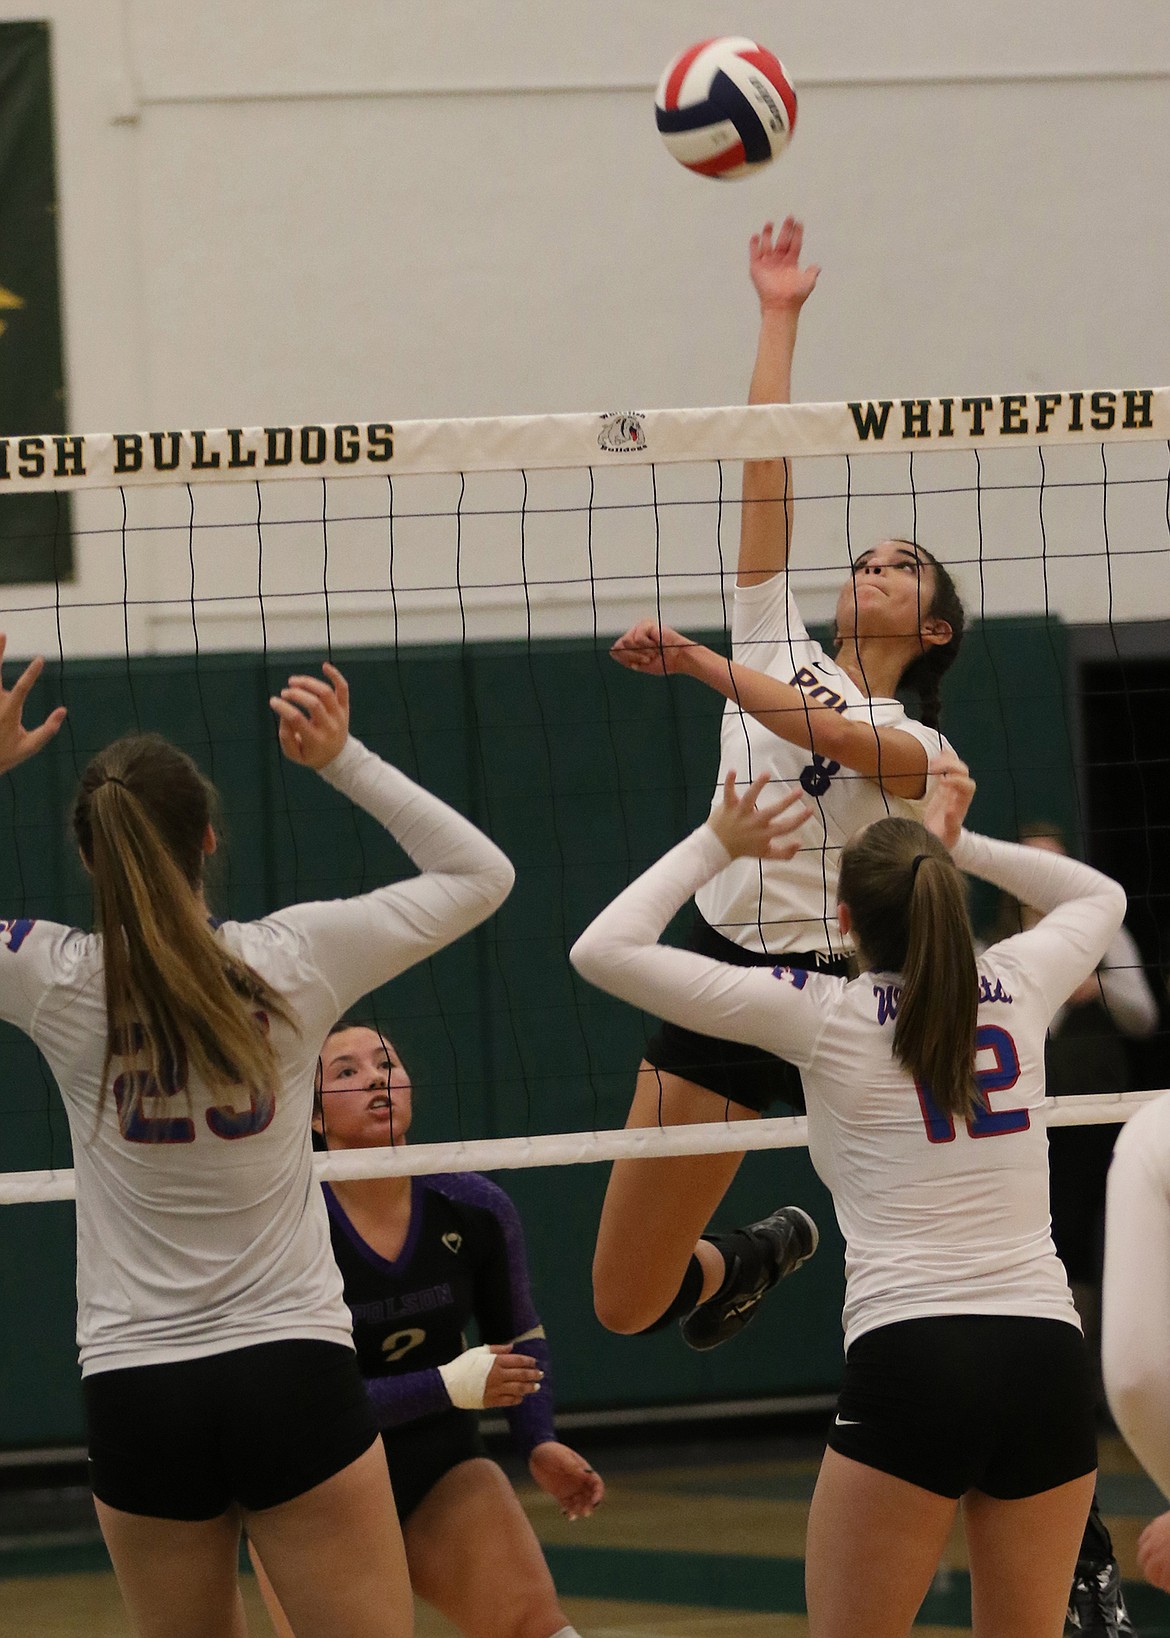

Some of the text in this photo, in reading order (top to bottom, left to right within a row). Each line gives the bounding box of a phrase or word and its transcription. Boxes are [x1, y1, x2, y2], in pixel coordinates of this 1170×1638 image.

[847, 389, 1154, 441] WHITEFISH
[113, 423, 394, 474] BULLDOGS
[789, 666, 848, 714] PO
